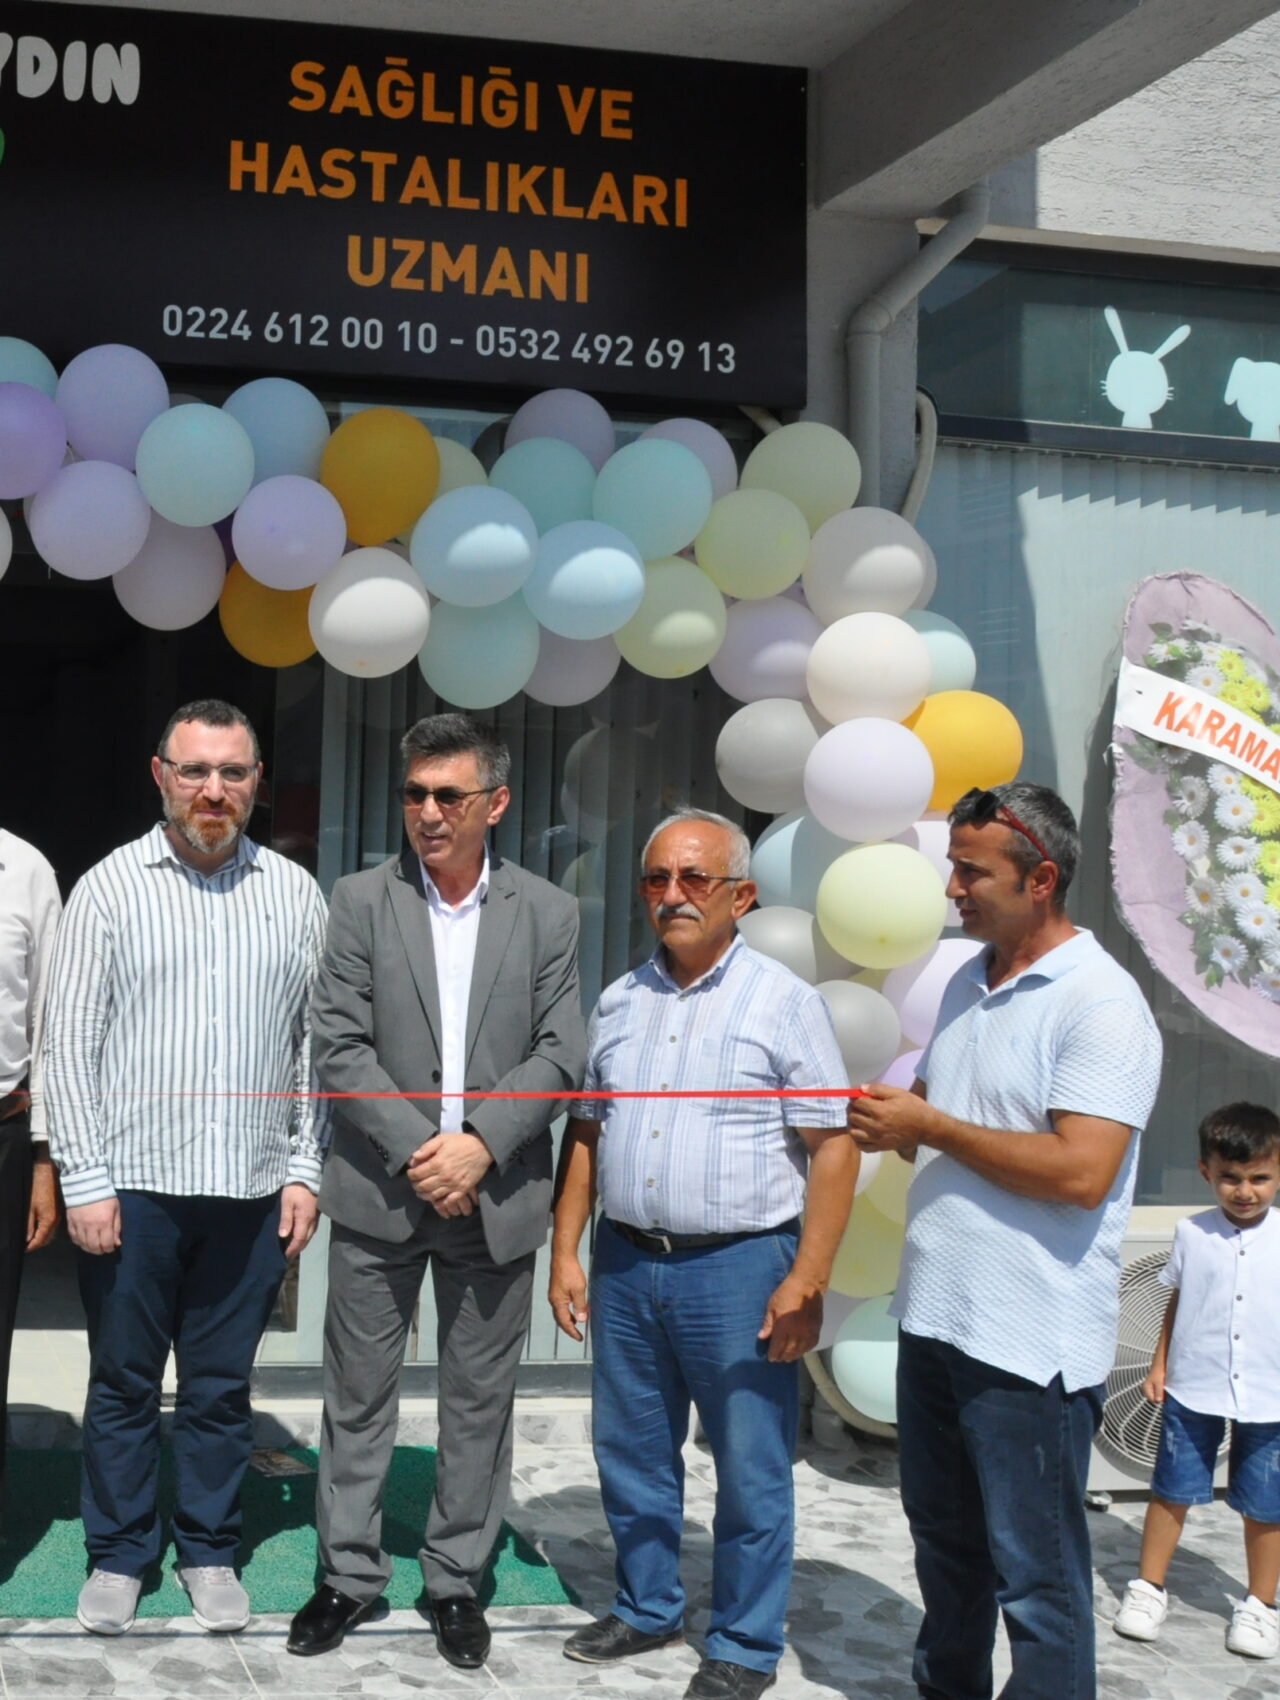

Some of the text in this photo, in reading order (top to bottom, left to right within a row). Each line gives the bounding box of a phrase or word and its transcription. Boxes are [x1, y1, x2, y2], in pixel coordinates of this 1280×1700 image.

[288, 57, 634, 140] SAĞLIĞI VE
[229, 140, 688, 228] HASTALIKLARI
[347, 235, 589, 303] UZMANI
[163, 304, 252, 342] 0224
[263, 311, 329, 348] 612
[341, 316, 384, 350] 00
[397, 321, 438, 354] 10
[475, 324, 560, 361] 0532
[571, 332, 634, 366] 492
[645, 338, 685, 370] 69
[698, 342, 736, 373] 13
